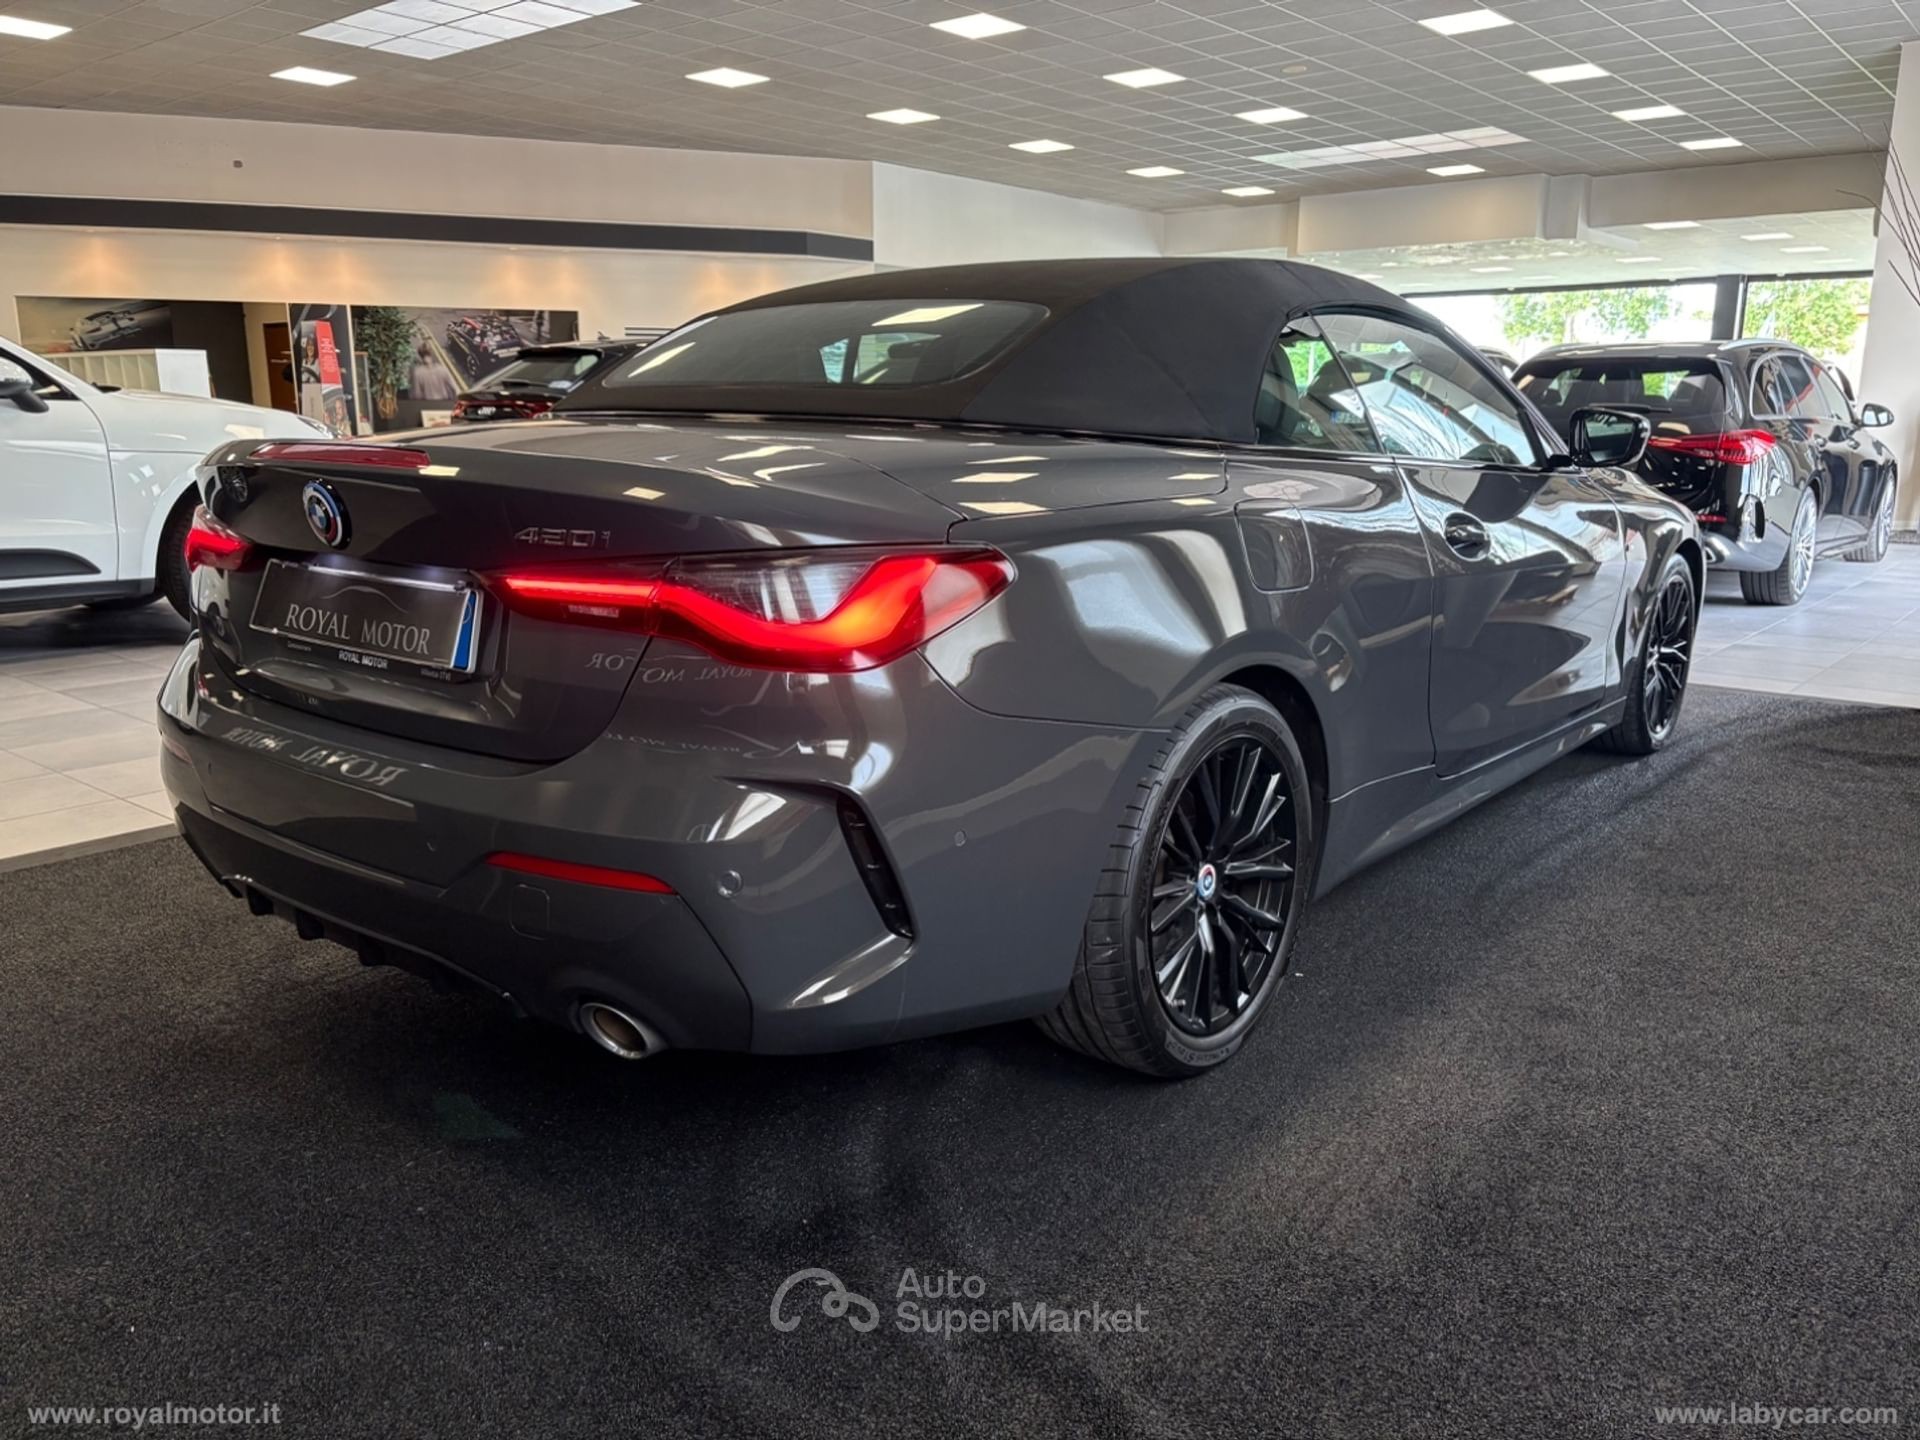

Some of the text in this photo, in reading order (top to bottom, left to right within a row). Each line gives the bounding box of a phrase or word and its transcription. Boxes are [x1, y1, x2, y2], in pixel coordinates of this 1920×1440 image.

[285, 604, 431, 655] ROYAL MOTOR
[338, 650, 389, 670] ROYAL MOTOR
